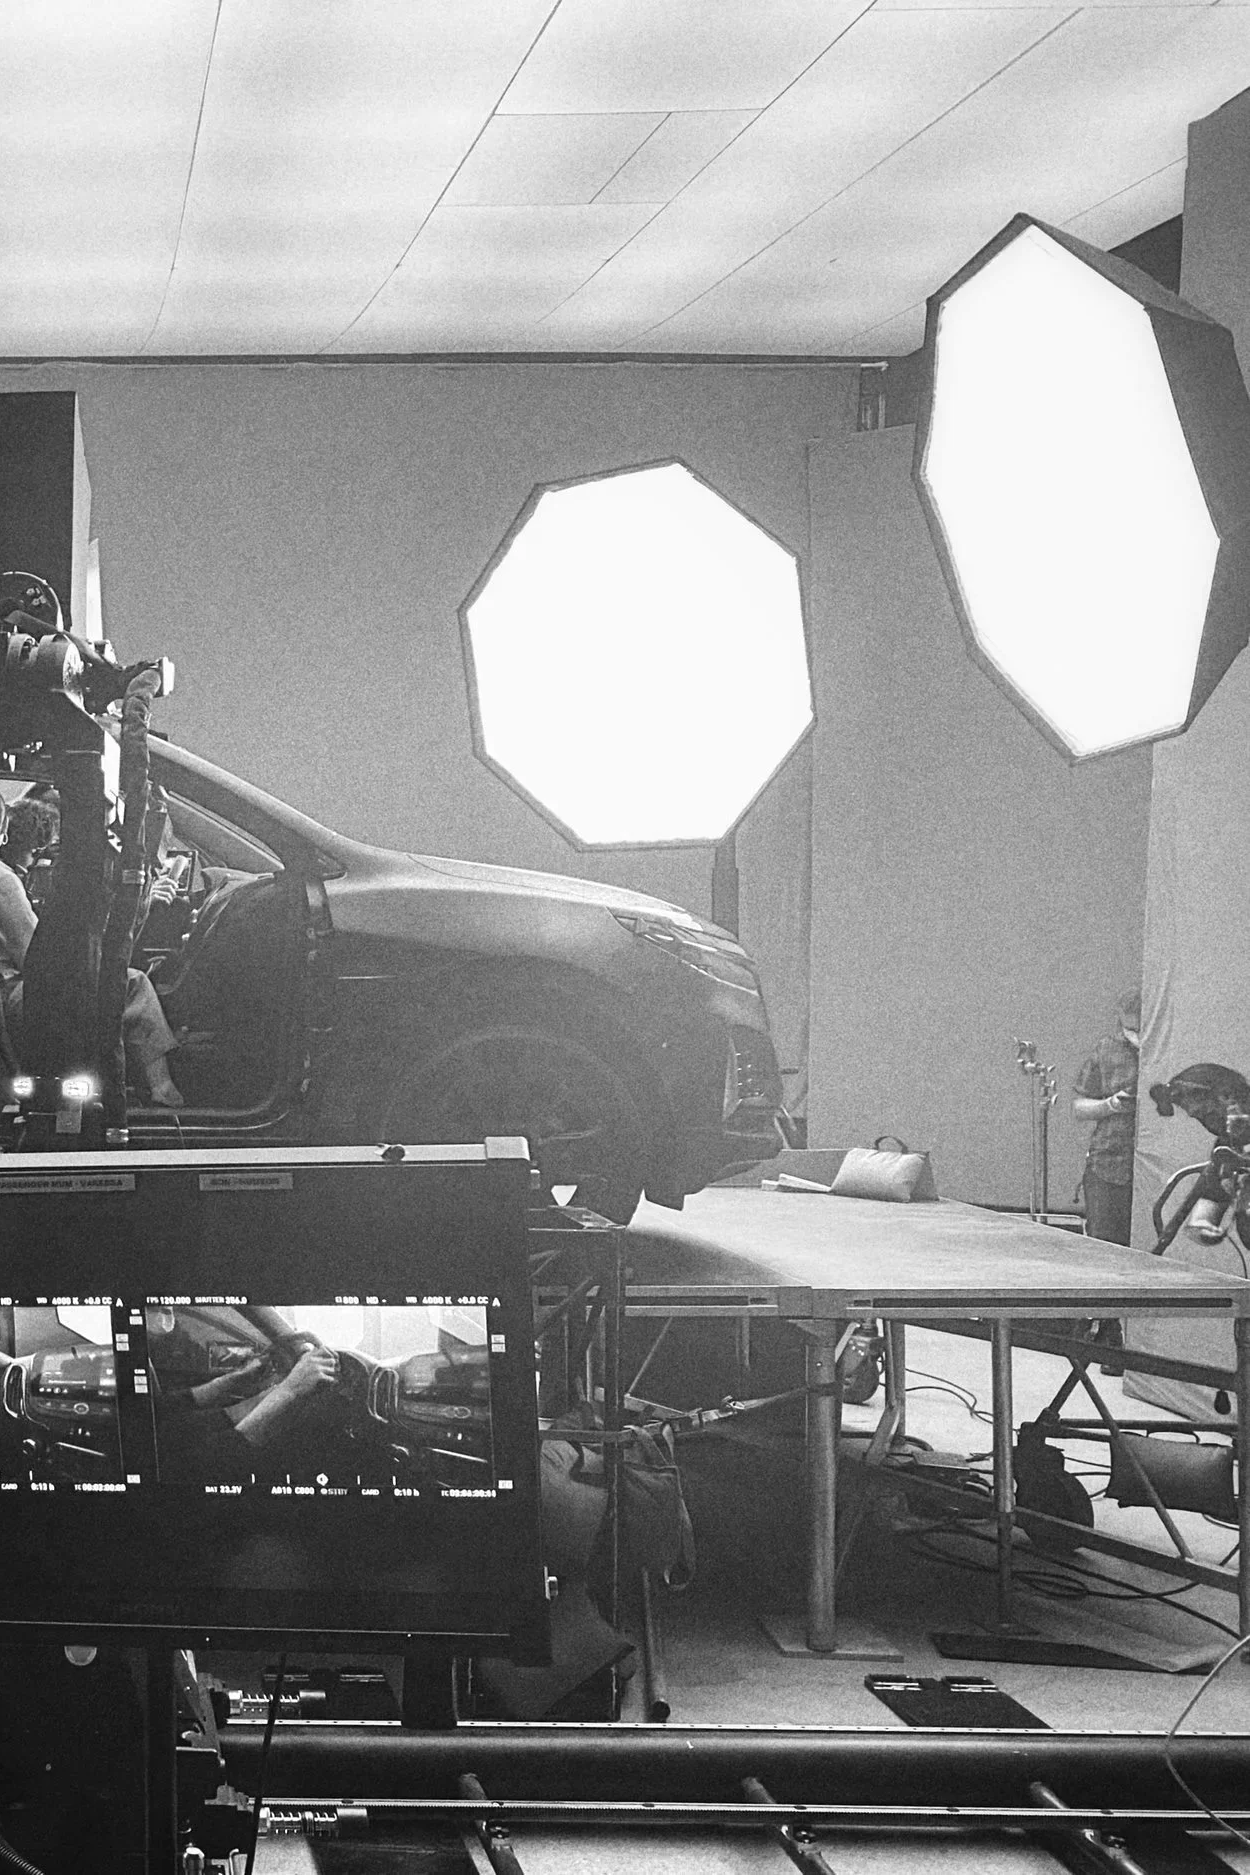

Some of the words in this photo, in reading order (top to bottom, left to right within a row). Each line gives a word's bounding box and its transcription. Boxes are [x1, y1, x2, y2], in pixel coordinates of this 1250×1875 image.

[51, 1180, 73, 1188] MUM
[1, 1297, 12, 1305] ND
[52, 1297, 71, 1305] 4000
[73, 1297, 79, 1305] K
[102, 1297, 112, 1305] CC
[116, 1298, 123, 1307] A
[343, 1296, 359, 1304] 800
[366, 1296, 379, 1304] ND
[422, 1296, 444, 1304] 4000
[445, 1296, 452, 1304] K
[477, 1296, 488, 1304] CC
[492, 1298, 500, 1307] A
